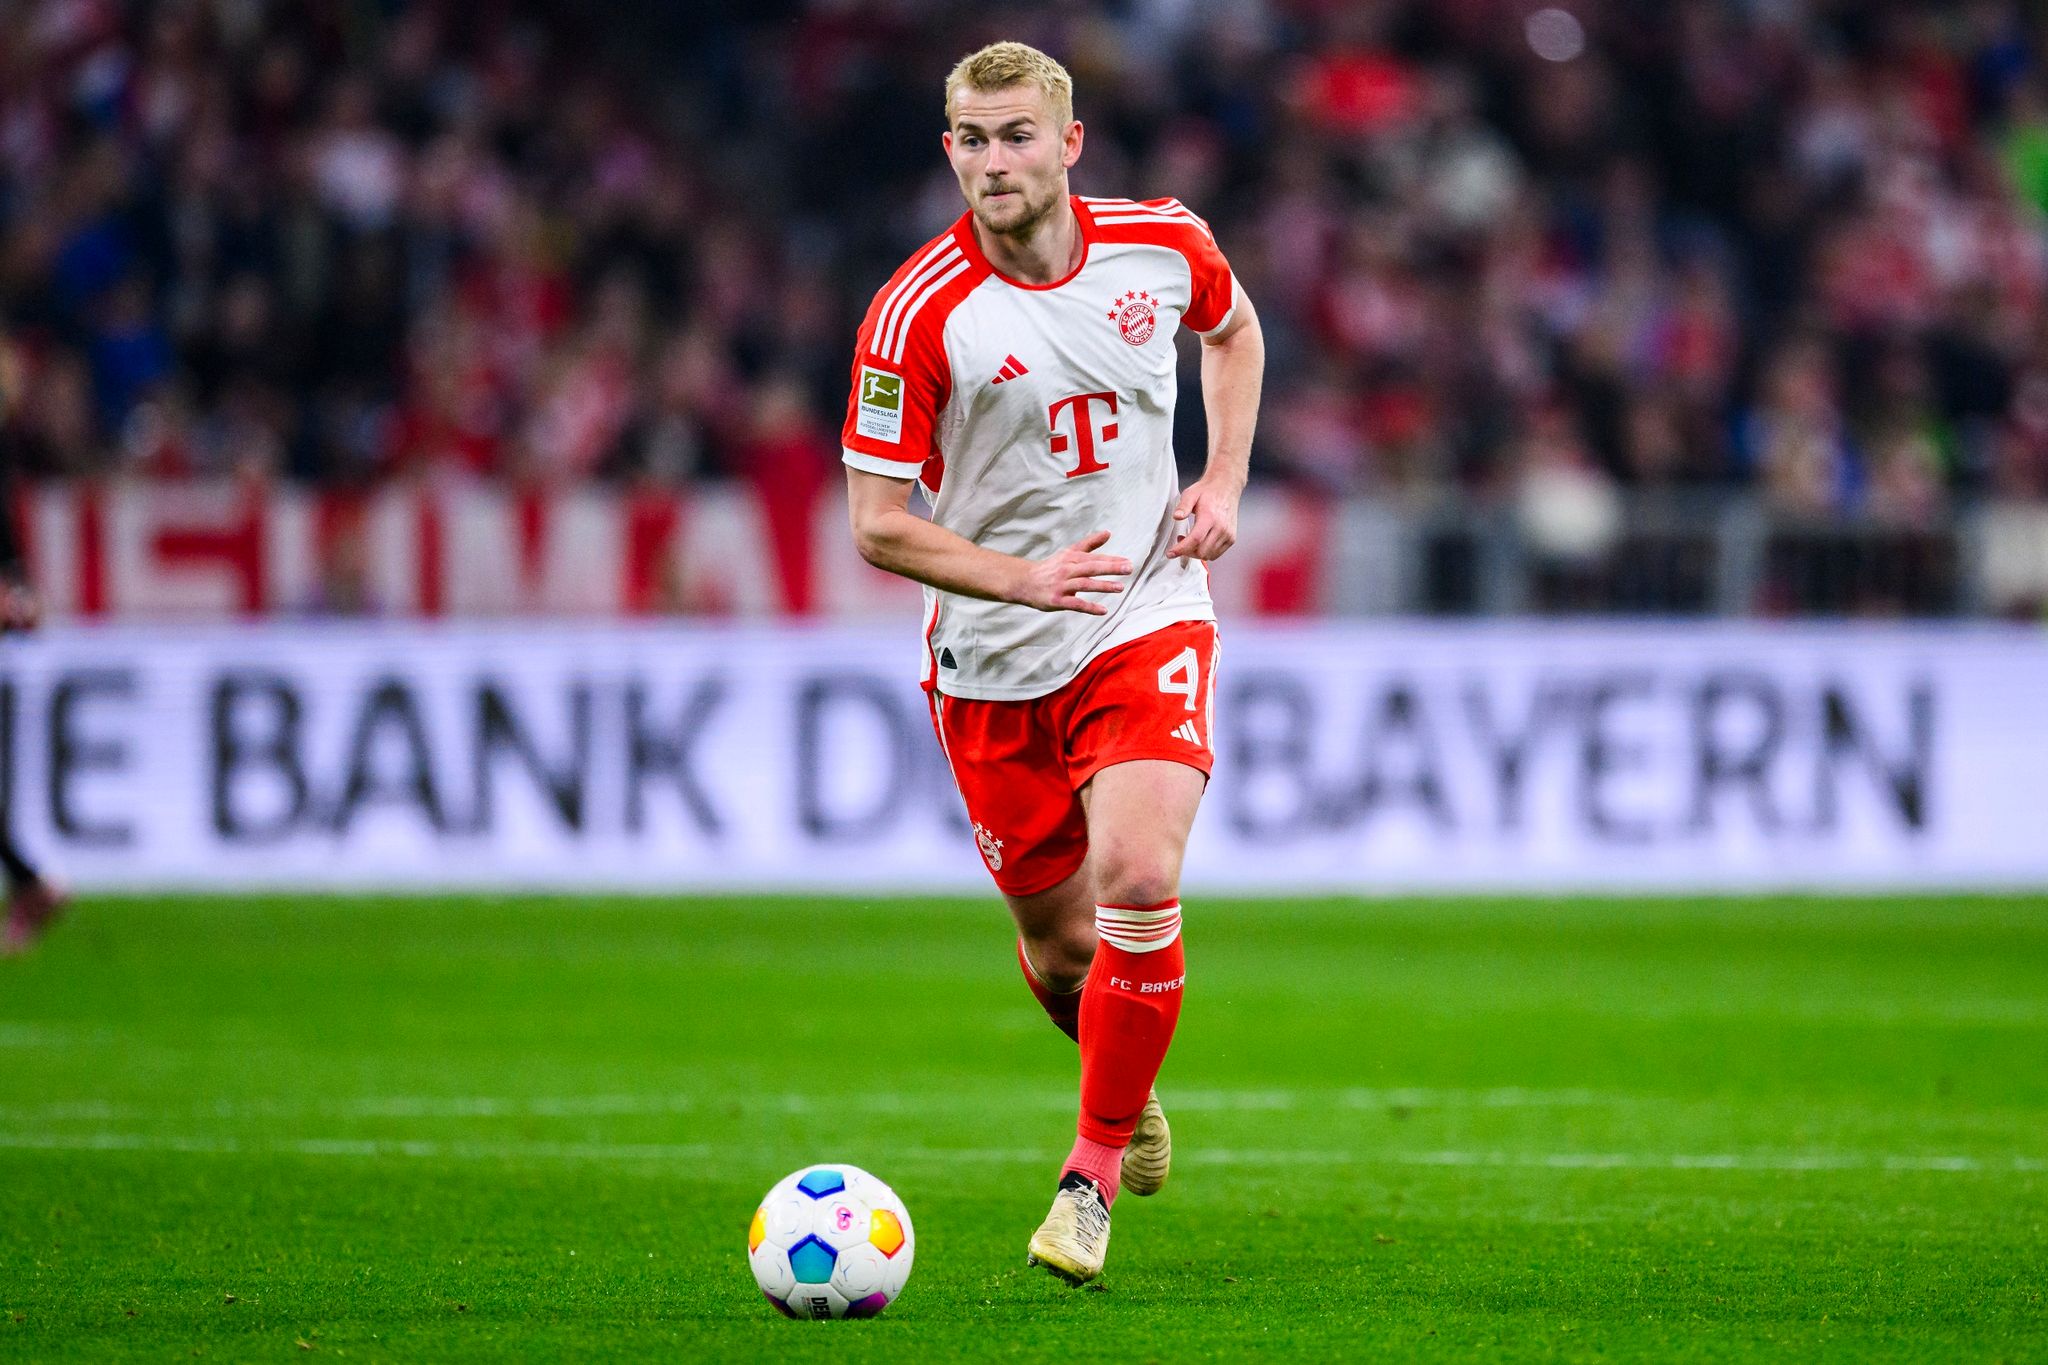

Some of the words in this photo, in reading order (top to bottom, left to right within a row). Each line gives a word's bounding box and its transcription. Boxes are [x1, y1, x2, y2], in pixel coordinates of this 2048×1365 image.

[1126, 305, 1152, 317] BAYERN
[861, 405, 898, 418] BUNDESLIGA
[1158, 646, 1199, 711] 4
[210, 668, 722, 845] BANK
[1224, 668, 1935, 845] BAYERN
[1110, 976, 1132, 990] FC
